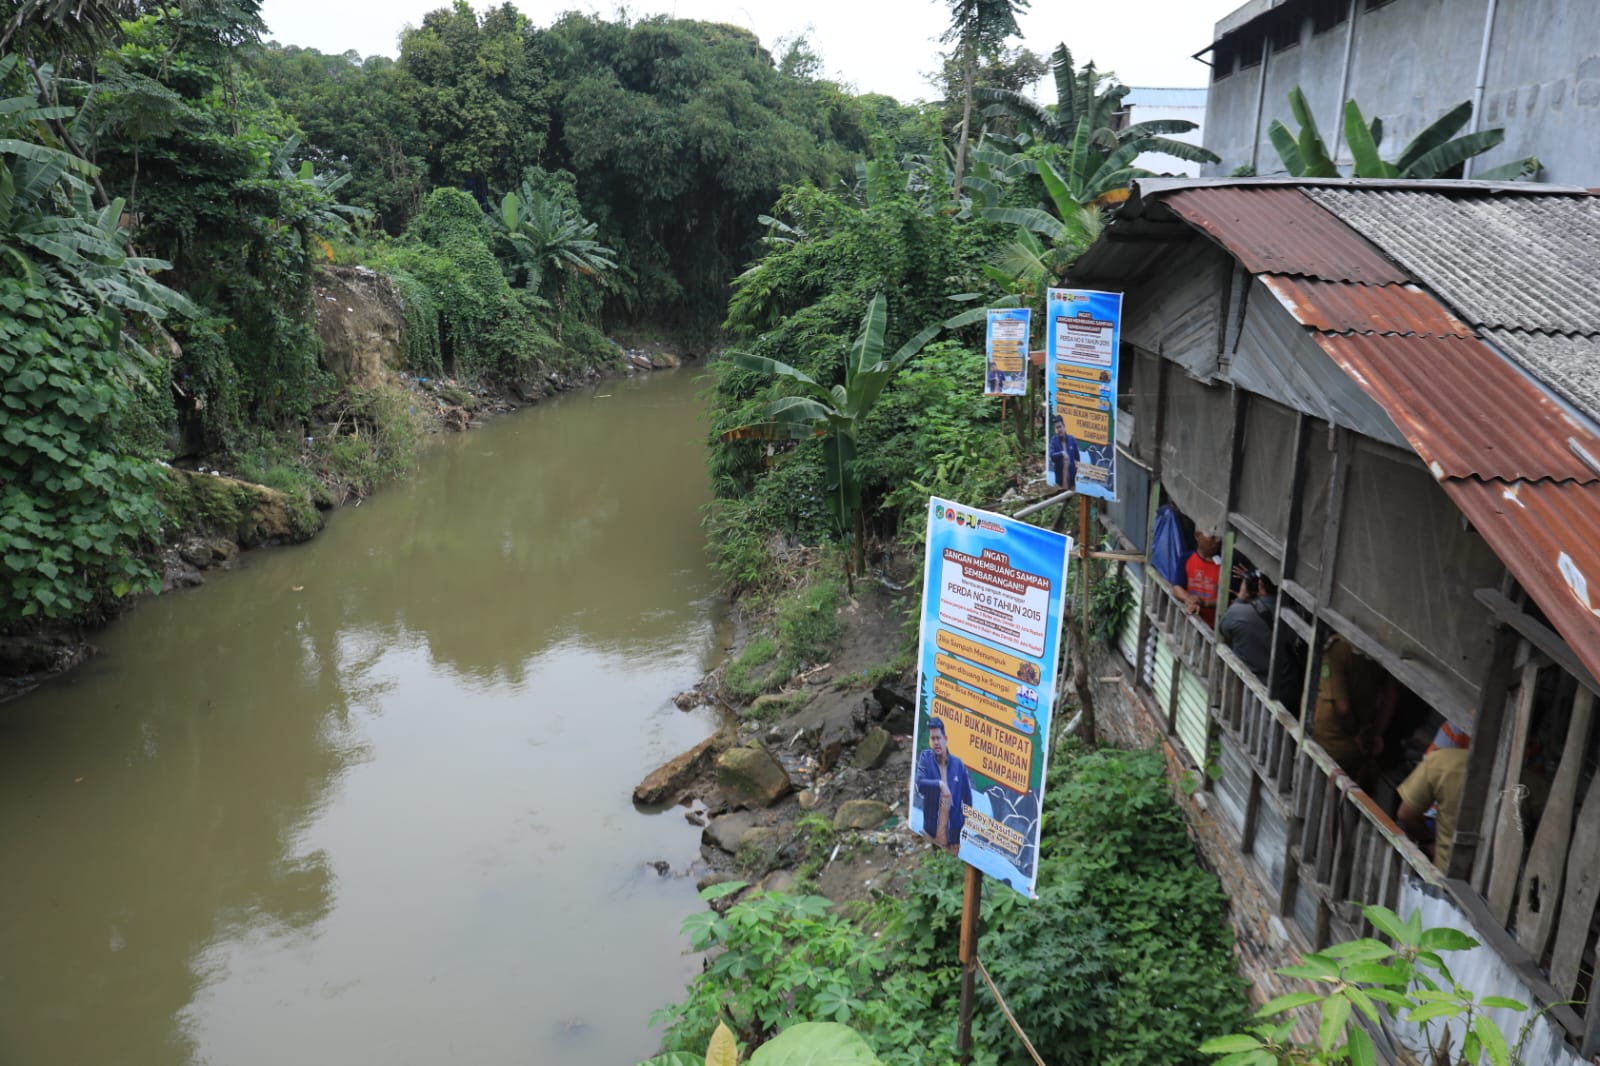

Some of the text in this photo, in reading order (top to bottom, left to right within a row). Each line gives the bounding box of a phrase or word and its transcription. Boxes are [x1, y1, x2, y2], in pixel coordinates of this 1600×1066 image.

[944, 549, 1050, 588] JANGAN MEMBUANG SAMPAH
[983, 549, 1008, 564] INGAT!
[963, 567, 1025, 592] SEMBARANGAN!!!
[947, 582, 1041, 621] PERDA NO 6 TAHUN 2015
[973, 645, 1007, 666] Menumpuk
[936, 657, 958, 672] Jangan
[957, 664, 981, 685] dibuang
[990, 677, 1011, 693] Sungai
[934, 701, 1030, 754] SUNGAI BUKAN TEMPAT
[969, 734, 1028, 771] PEMBUANGAN
[982, 757, 1027, 788] SAMPAH!!!
[963, 804, 1024, 844] Bobby Nasution
